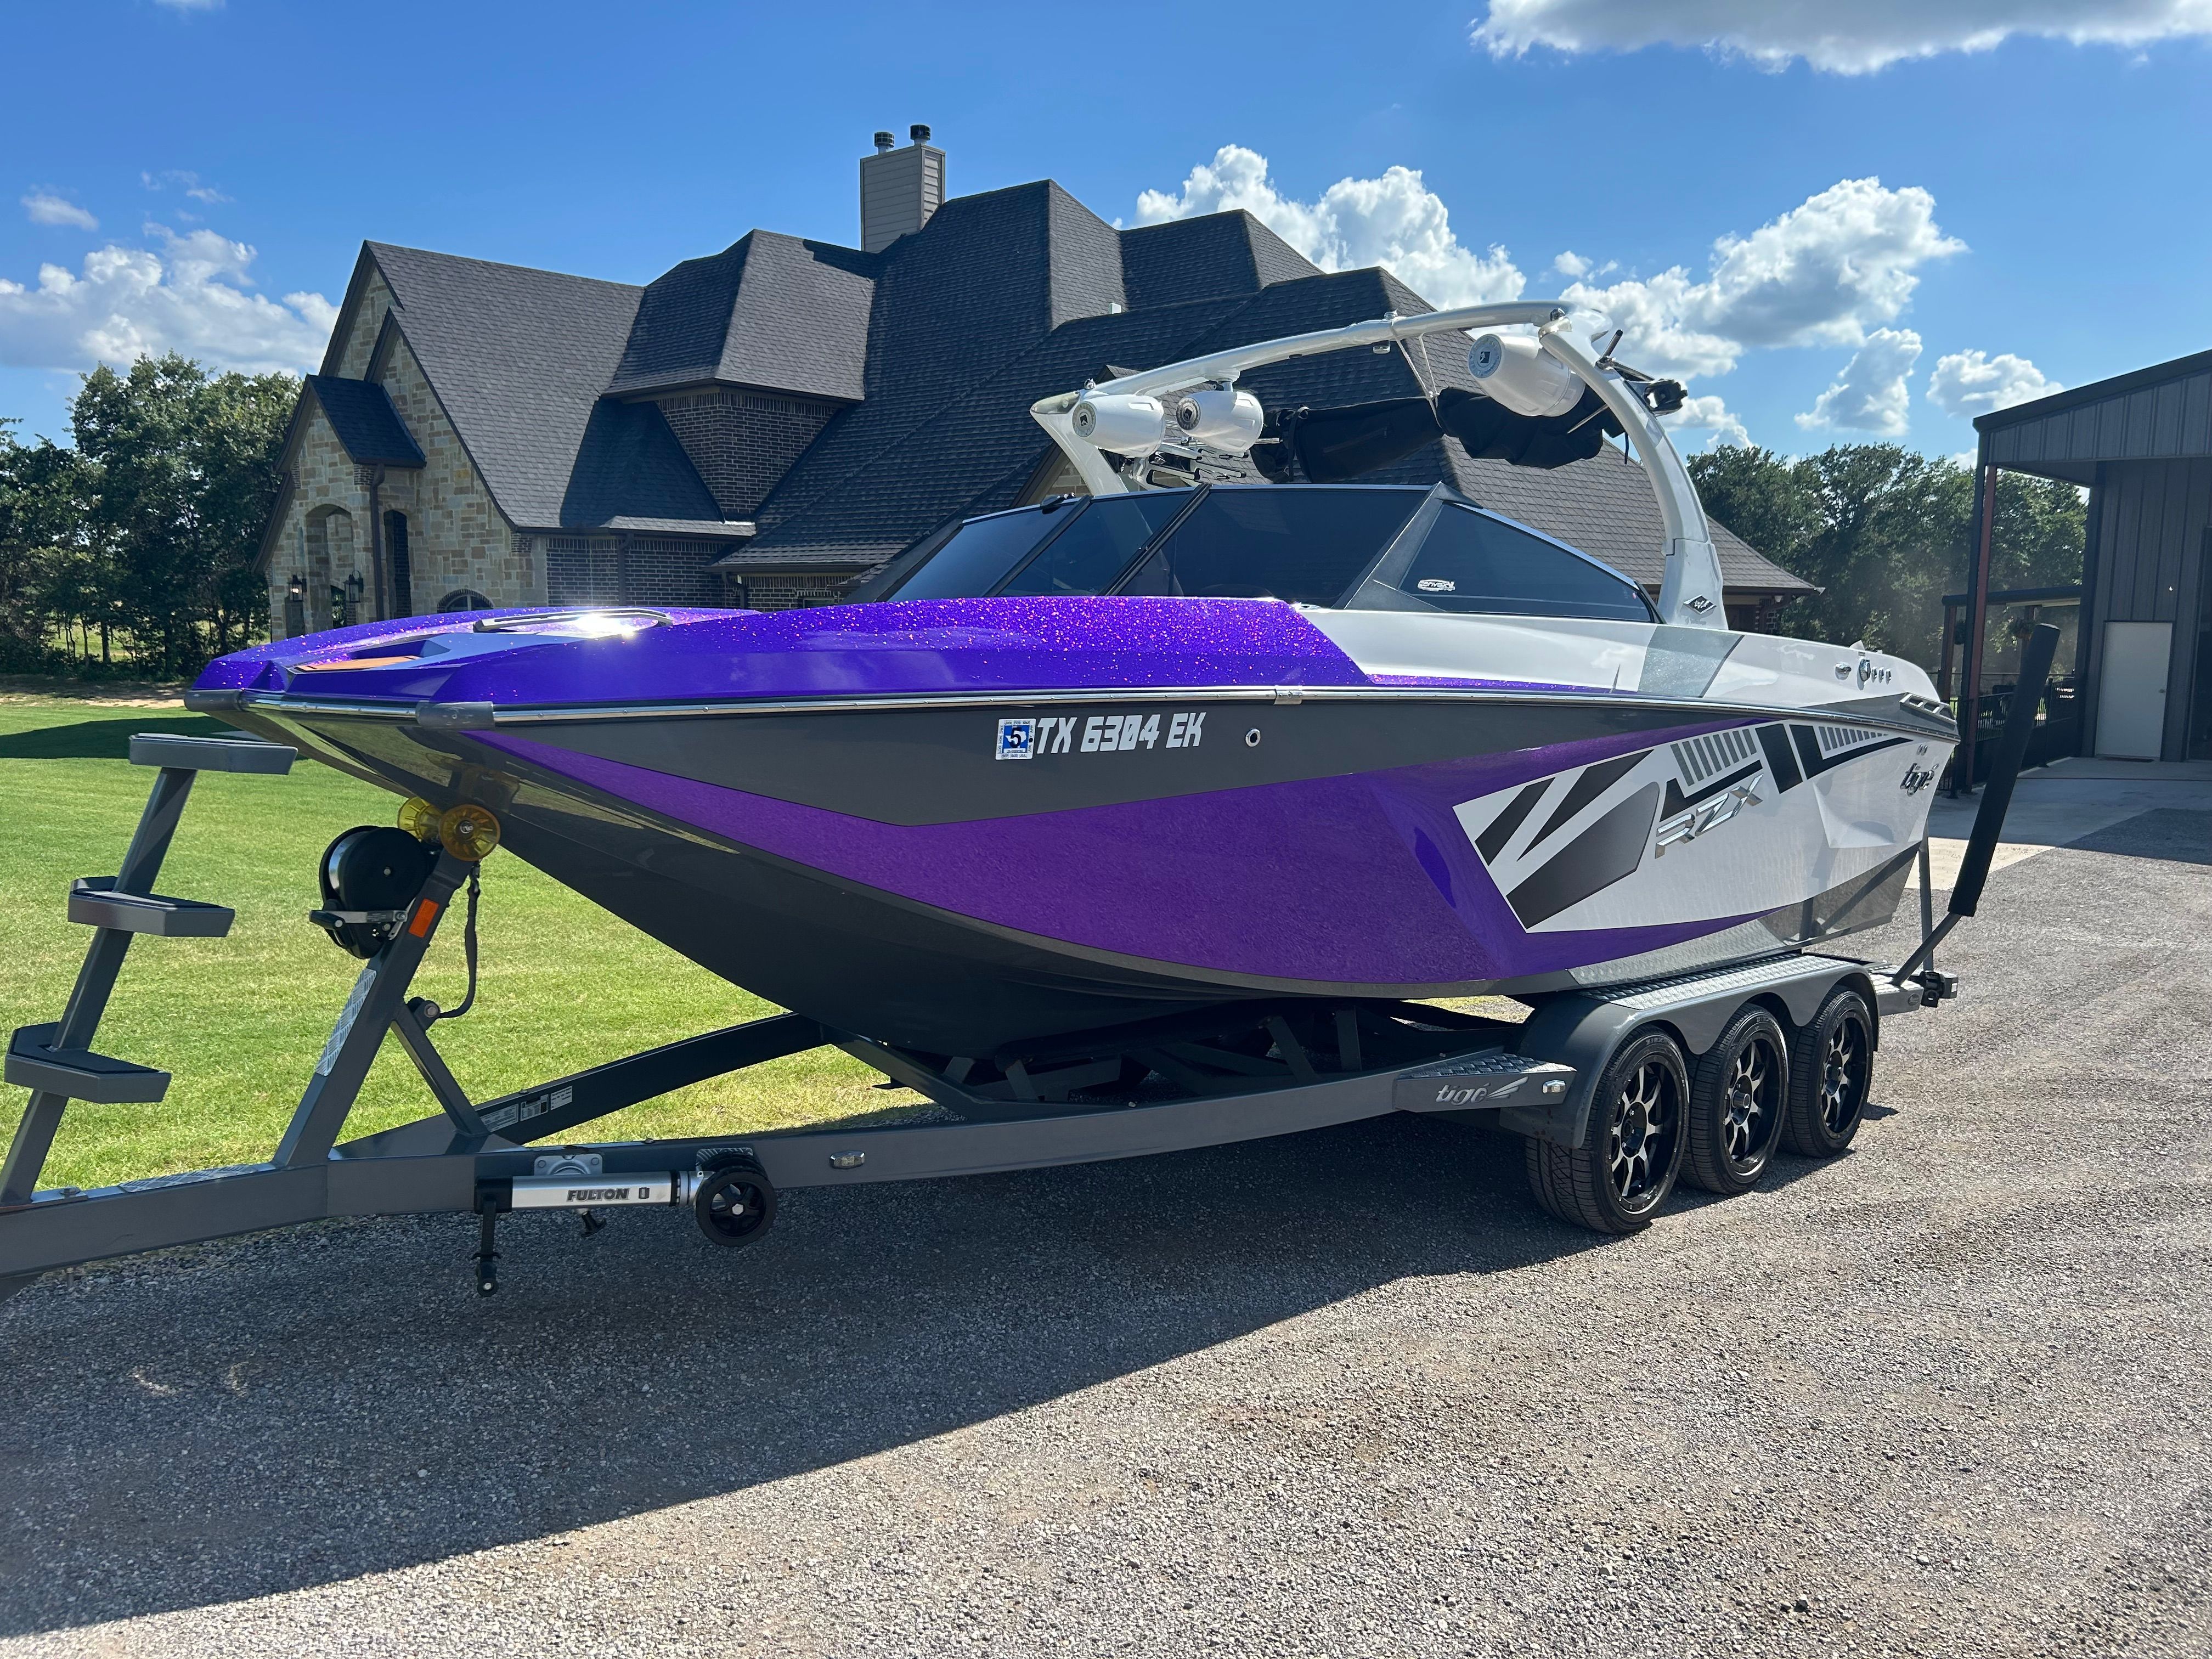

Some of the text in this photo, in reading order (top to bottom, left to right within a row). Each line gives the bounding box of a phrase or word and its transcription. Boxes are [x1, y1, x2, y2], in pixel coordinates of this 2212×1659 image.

[1009, 726, 1022, 748] 5
[1036, 712, 1207, 754] TX 6304 EK
[1654, 773, 1763, 859] RZX
[567, 1188, 630, 1202] FULTON
